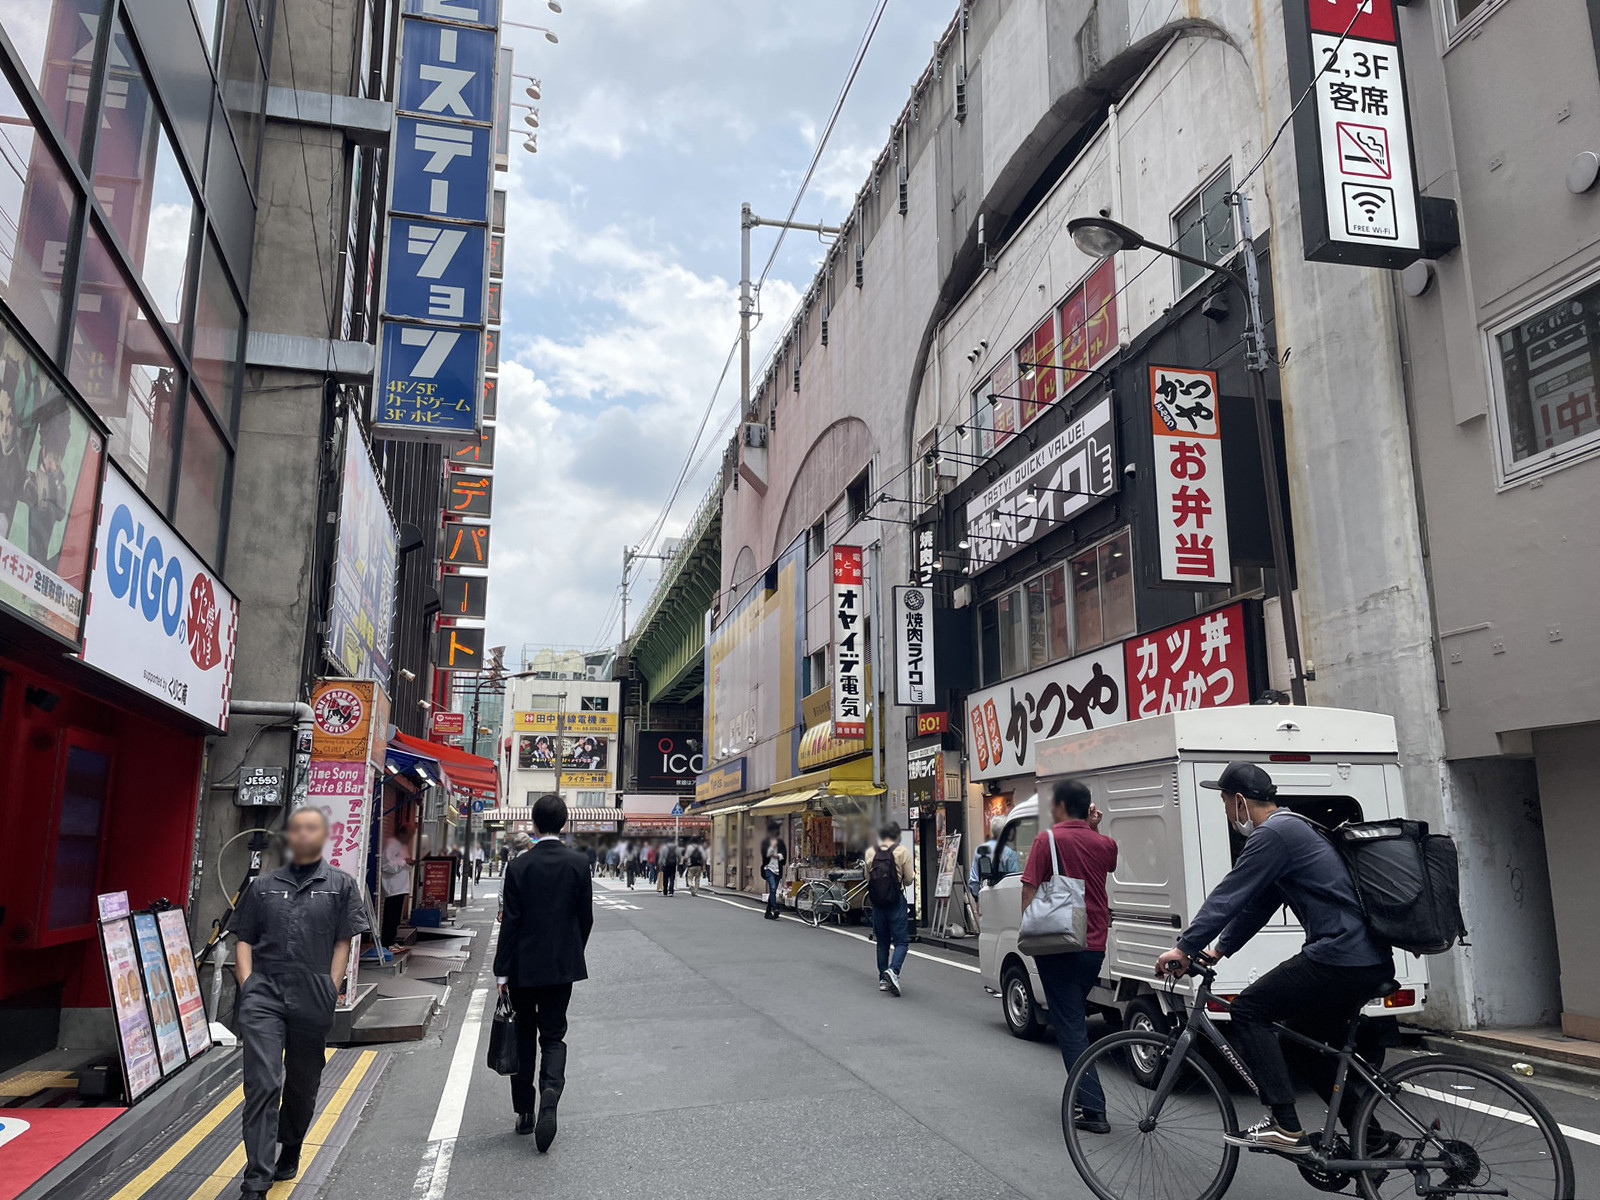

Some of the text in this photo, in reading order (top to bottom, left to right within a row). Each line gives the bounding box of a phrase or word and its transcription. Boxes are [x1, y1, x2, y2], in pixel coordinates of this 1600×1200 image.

[1322, 47, 1389, 80] 2,3F
[1329, 82, 1389, 116] 客席
[1353, 224, 1391, 235] FREE Wi-Fi
[386, 381, 438, 395] 4F/5F
[386, 393, 471, 412] カードゲーム
[1156, 374, 1214, 430] かつや
[384, 409, 454, 423] 3F ホビー
[982, 421, 1085, 507] TASTY! QUICK! VALUE!
[1169, 441, 1216, 578] お弁当
[837, 589, 860, 718] オヤイデ電気
[1136, 612, 1231, 682] カツ丼
[1138, 667, 1235, 718] とんかつ
[919, 717, 940, 732] GO!
[1006, 661, 1120, 767] かつや
[245, 776, 278, 785] JESS3
[309, 780, 364, 793] Cafe & Bar
[332, 767, 359, 781] Song
[346, 799, 363, 852] アニソン
